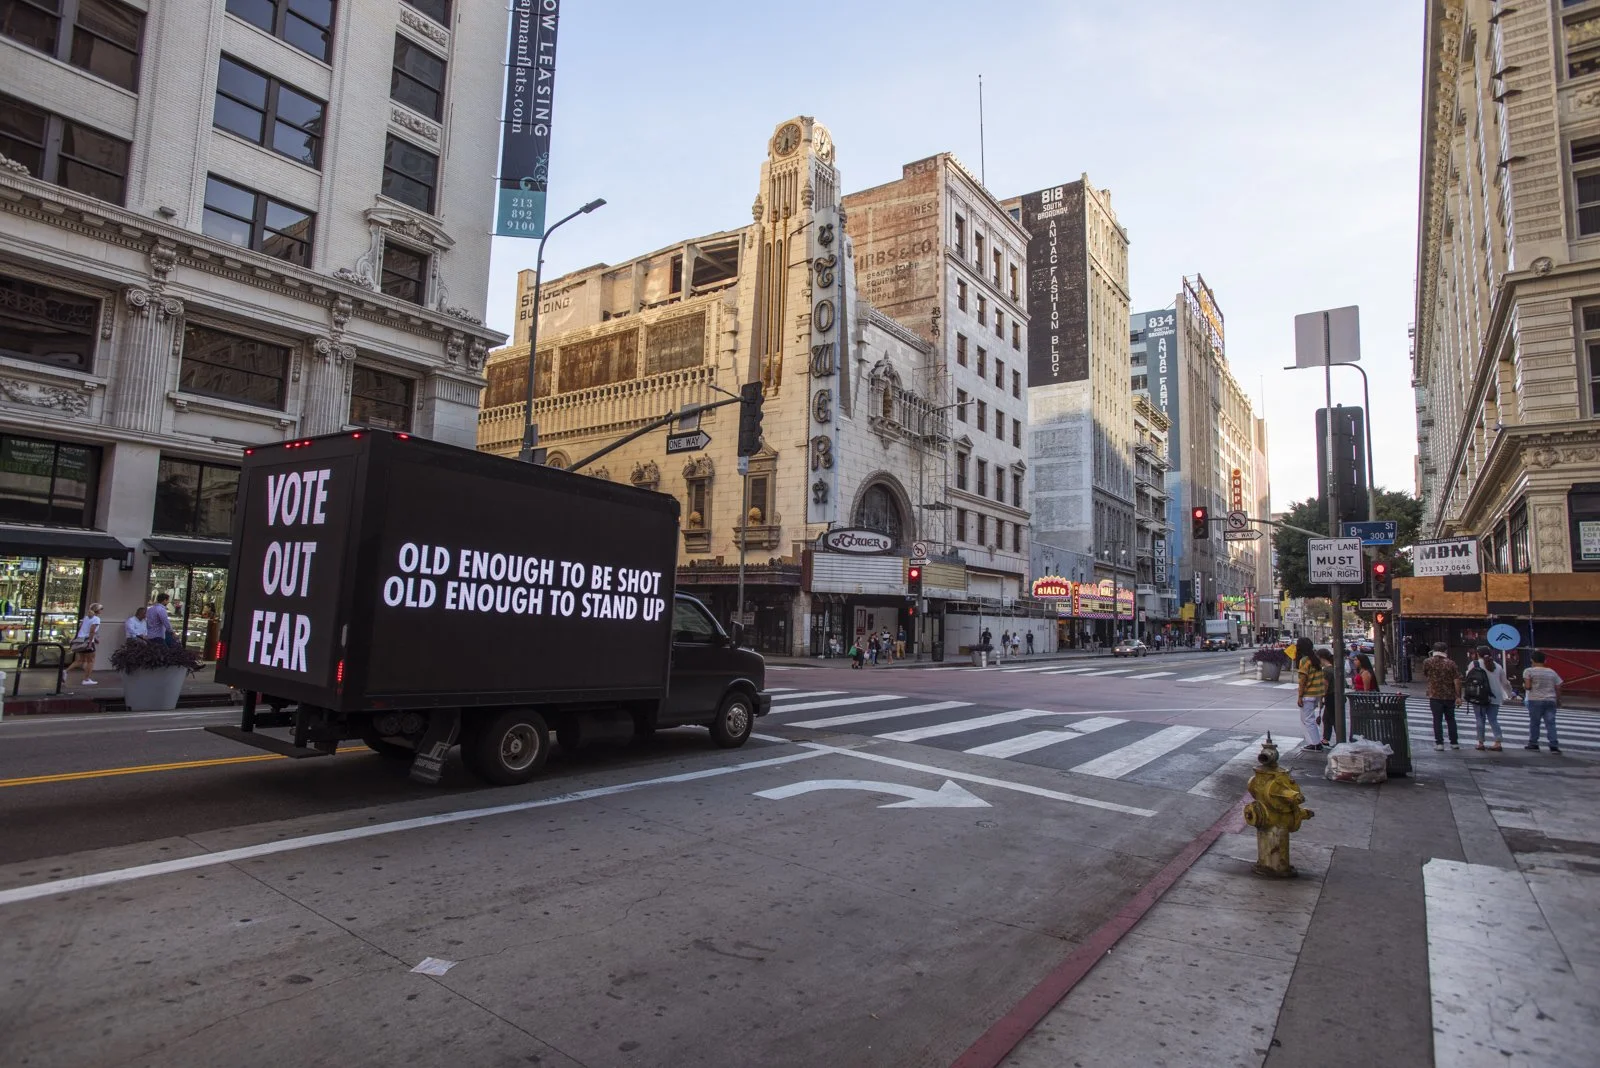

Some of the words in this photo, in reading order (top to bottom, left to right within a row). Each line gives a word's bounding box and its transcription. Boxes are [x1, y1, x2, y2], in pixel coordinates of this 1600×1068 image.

[511, 0, 531, 134] apmanflats.com
[534, 41, 553, 137] LEASING
[512, 198, 533, 208] 213
[1041, 186, 1063, 204] 818
[511, 210, 532, 219] 892
[1037, 206, 1068, 221] BROADWAY
[1042, 201, 1062, 212] SOUTH
[507, 220, 535, 231] 9100
[1049, 219, 1058, 264] ANJAC
[521, 286, 570, 308] SIGER
[1050, 266, 1059, 330] FASHION
[520, 297, 570, 321] BULDING
[1148, 314, 1175, 328] 834
[1158, 338, 1167, 374] ANJAC
[669, 438, 682, 449] ONE
[685, 436, 700, 447] WAY
[268, 468, 331, 526] VOTE
[1385, 522, 1393, 530] St
[1370, 532, 1385, 540] 300
[1337, 543, 1359, 551] LANE
[1419, 544, 1470, 560] MDM
[262, 541, 317, 597] OUT
[398, 542, 450, 576] OLD
[458, 549, 554, 586] ENOUGH
[560, 561, 585, 588] TO
[591, 565, 612, 591] BE
[617, 568, 662, 595] SHOT
[1156, 540, 1165, 582] LYNNS
[1316, 556, 1354, 565] MUST
[1337, 570, 1359, 578] RIGHT
[383, 576, 437, 608] OLD
[445, 581, 543, 615] ENOUGH
[550, 590, 575, 617] TO
[581, 593, 637, 620] STAND
[643, 598, 665, 621] UP
[1037, 586, 1067, 595] RIALTO
[248, 609, 311, 673] FEAR
